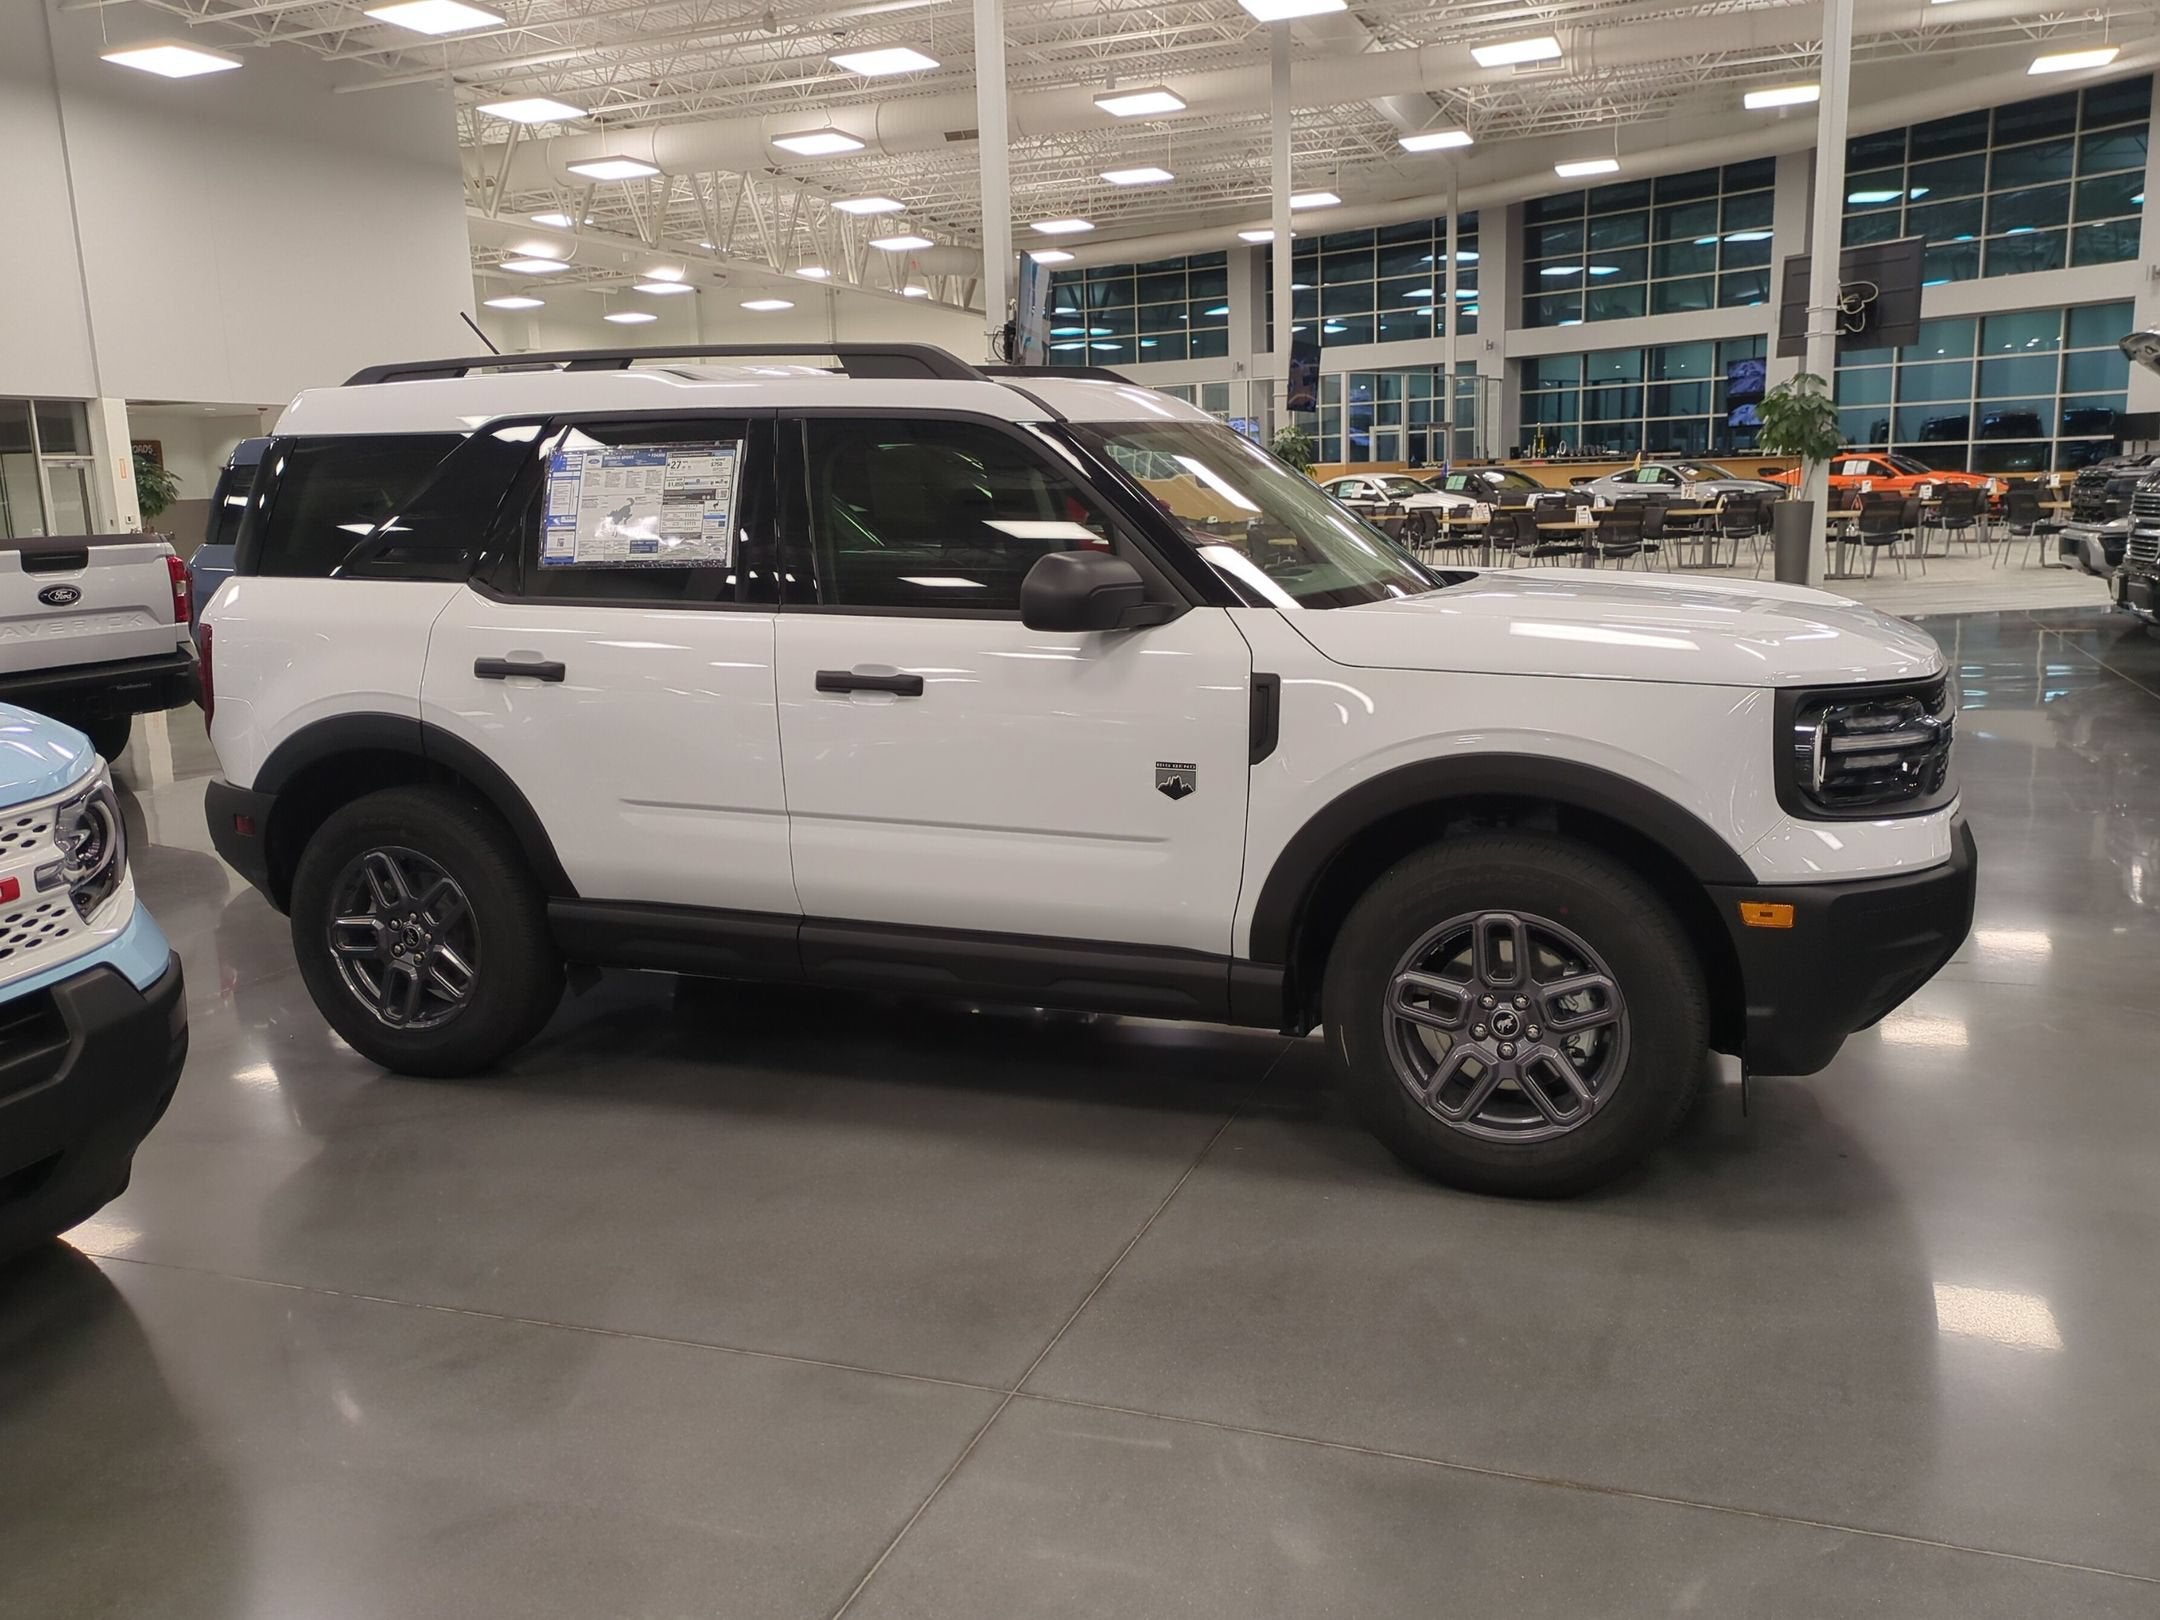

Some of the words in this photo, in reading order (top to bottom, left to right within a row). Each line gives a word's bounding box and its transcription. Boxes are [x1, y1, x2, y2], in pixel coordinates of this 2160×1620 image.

[132, 444, 154, 454] OADS
[671, 460, 682, 469] 27
[0, 614, 144, 639] AVERICK
